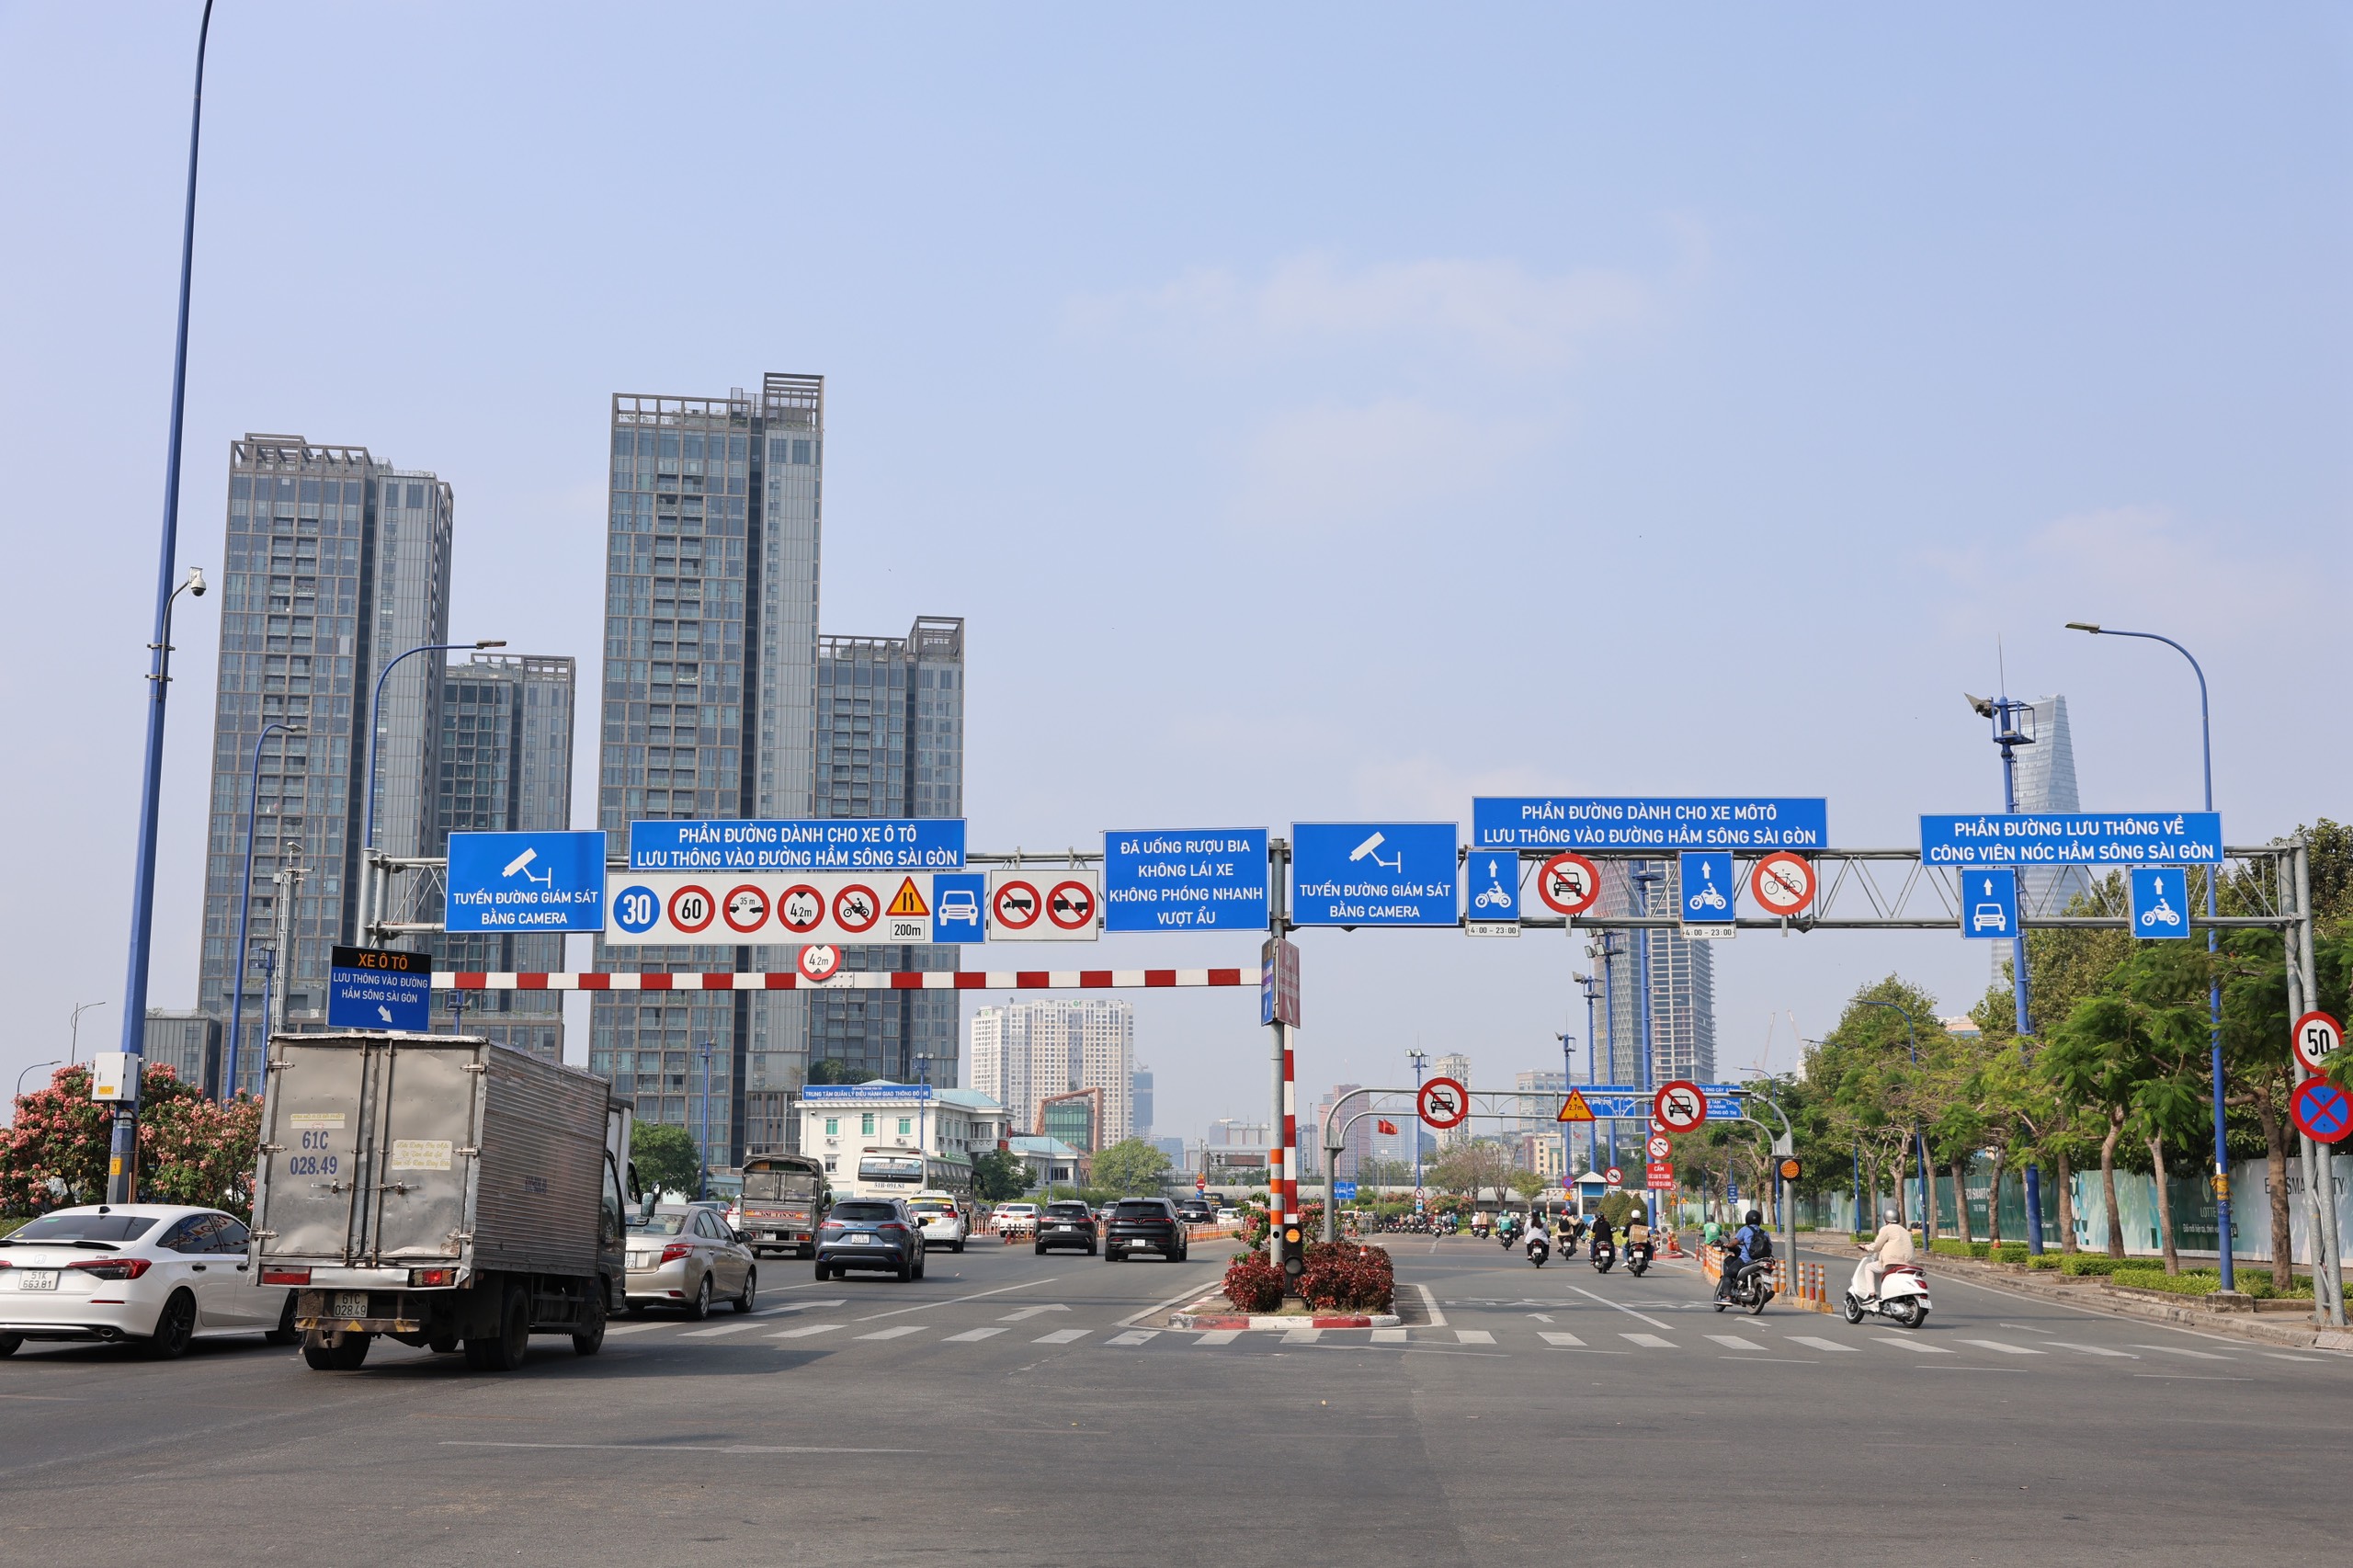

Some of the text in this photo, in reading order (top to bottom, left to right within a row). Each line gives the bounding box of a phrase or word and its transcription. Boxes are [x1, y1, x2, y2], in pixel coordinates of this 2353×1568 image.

[1523, 801, 1777, 820] PHẦN ĐƯỜNG DÀNH CHO XE MÔTÔ
[679, 823, 917, 843] PHẦN ĐƯỜNG DÀNH CHO XE Ô TÔ
[1955, 814, 2185, 836] PHẦN ĐƯỜNG LƯU THÔNG VỀ
[1484, 824, 1816, 845] LƯU THÔNG VÀO ĐƯỜNG HẦM SÔNG SÀI GÒN
[1120, 836, 1251, 856] ĐÃ UỐNG RƯỢU BIA
[1931, 840, 2214, 861] CÔNG VIÊN NÓC HẦM SÔNG SÀI GÒN
[638, 845, 957, 867] LƯU THÔNG VÀO ĐƯỜNG HẦM SÔNG SÀI GÒN
[1139, 860, 1234, 878] KHÔNG LÁI XE
[454, 888, 598, 904] TUYẾN ĐƯỜNG GIÁM SÁT
[1109, 884, 1263, 903] KHÔNG PHÓNG NHANH
[1300, 881, 1451, 897] TUYẾN ĐƯỜNG GIÁM SÁT
[623, 894, 651, 925] 30
[682, 898, 702, 920] 60
[740, 897, 748, 905] 35
[790, 903, 813, 917] 4.2m
[1330, 902, 1420, 918] BẰNG CAMERA
[482, 909, 568, 925] BẰNG CAMERA
[1157, 906, 1216, 927] VƯỢT ẨU
[894, 924, 921, 936] 200m
[358, 952, 408, 970] XE Ô TÔ
[809, 953, 829, 966] 4.2m
[333, 972, 427, 988] LƯU THÔNG VÀO ĐƯỜNG
[342, 985, 417, 1003] HẦM SÔNG SÀI GÒN
[2307, 1028, 2330, 1056] 50
[302, 1131, 329, 1150] 61C
[290, 1155, 337, 1176] 028.49
[2287, 1177, 2306, 1195] SMA
[2200, 1206, 2217, 1218] LOTTE
[31, 1271, 48, 1279] 51K
[23, 1280, 52, 1289] 663.81
[342, 1293, 360, 1305] 61C
[335, 1304, 367, 1316] 028.49
